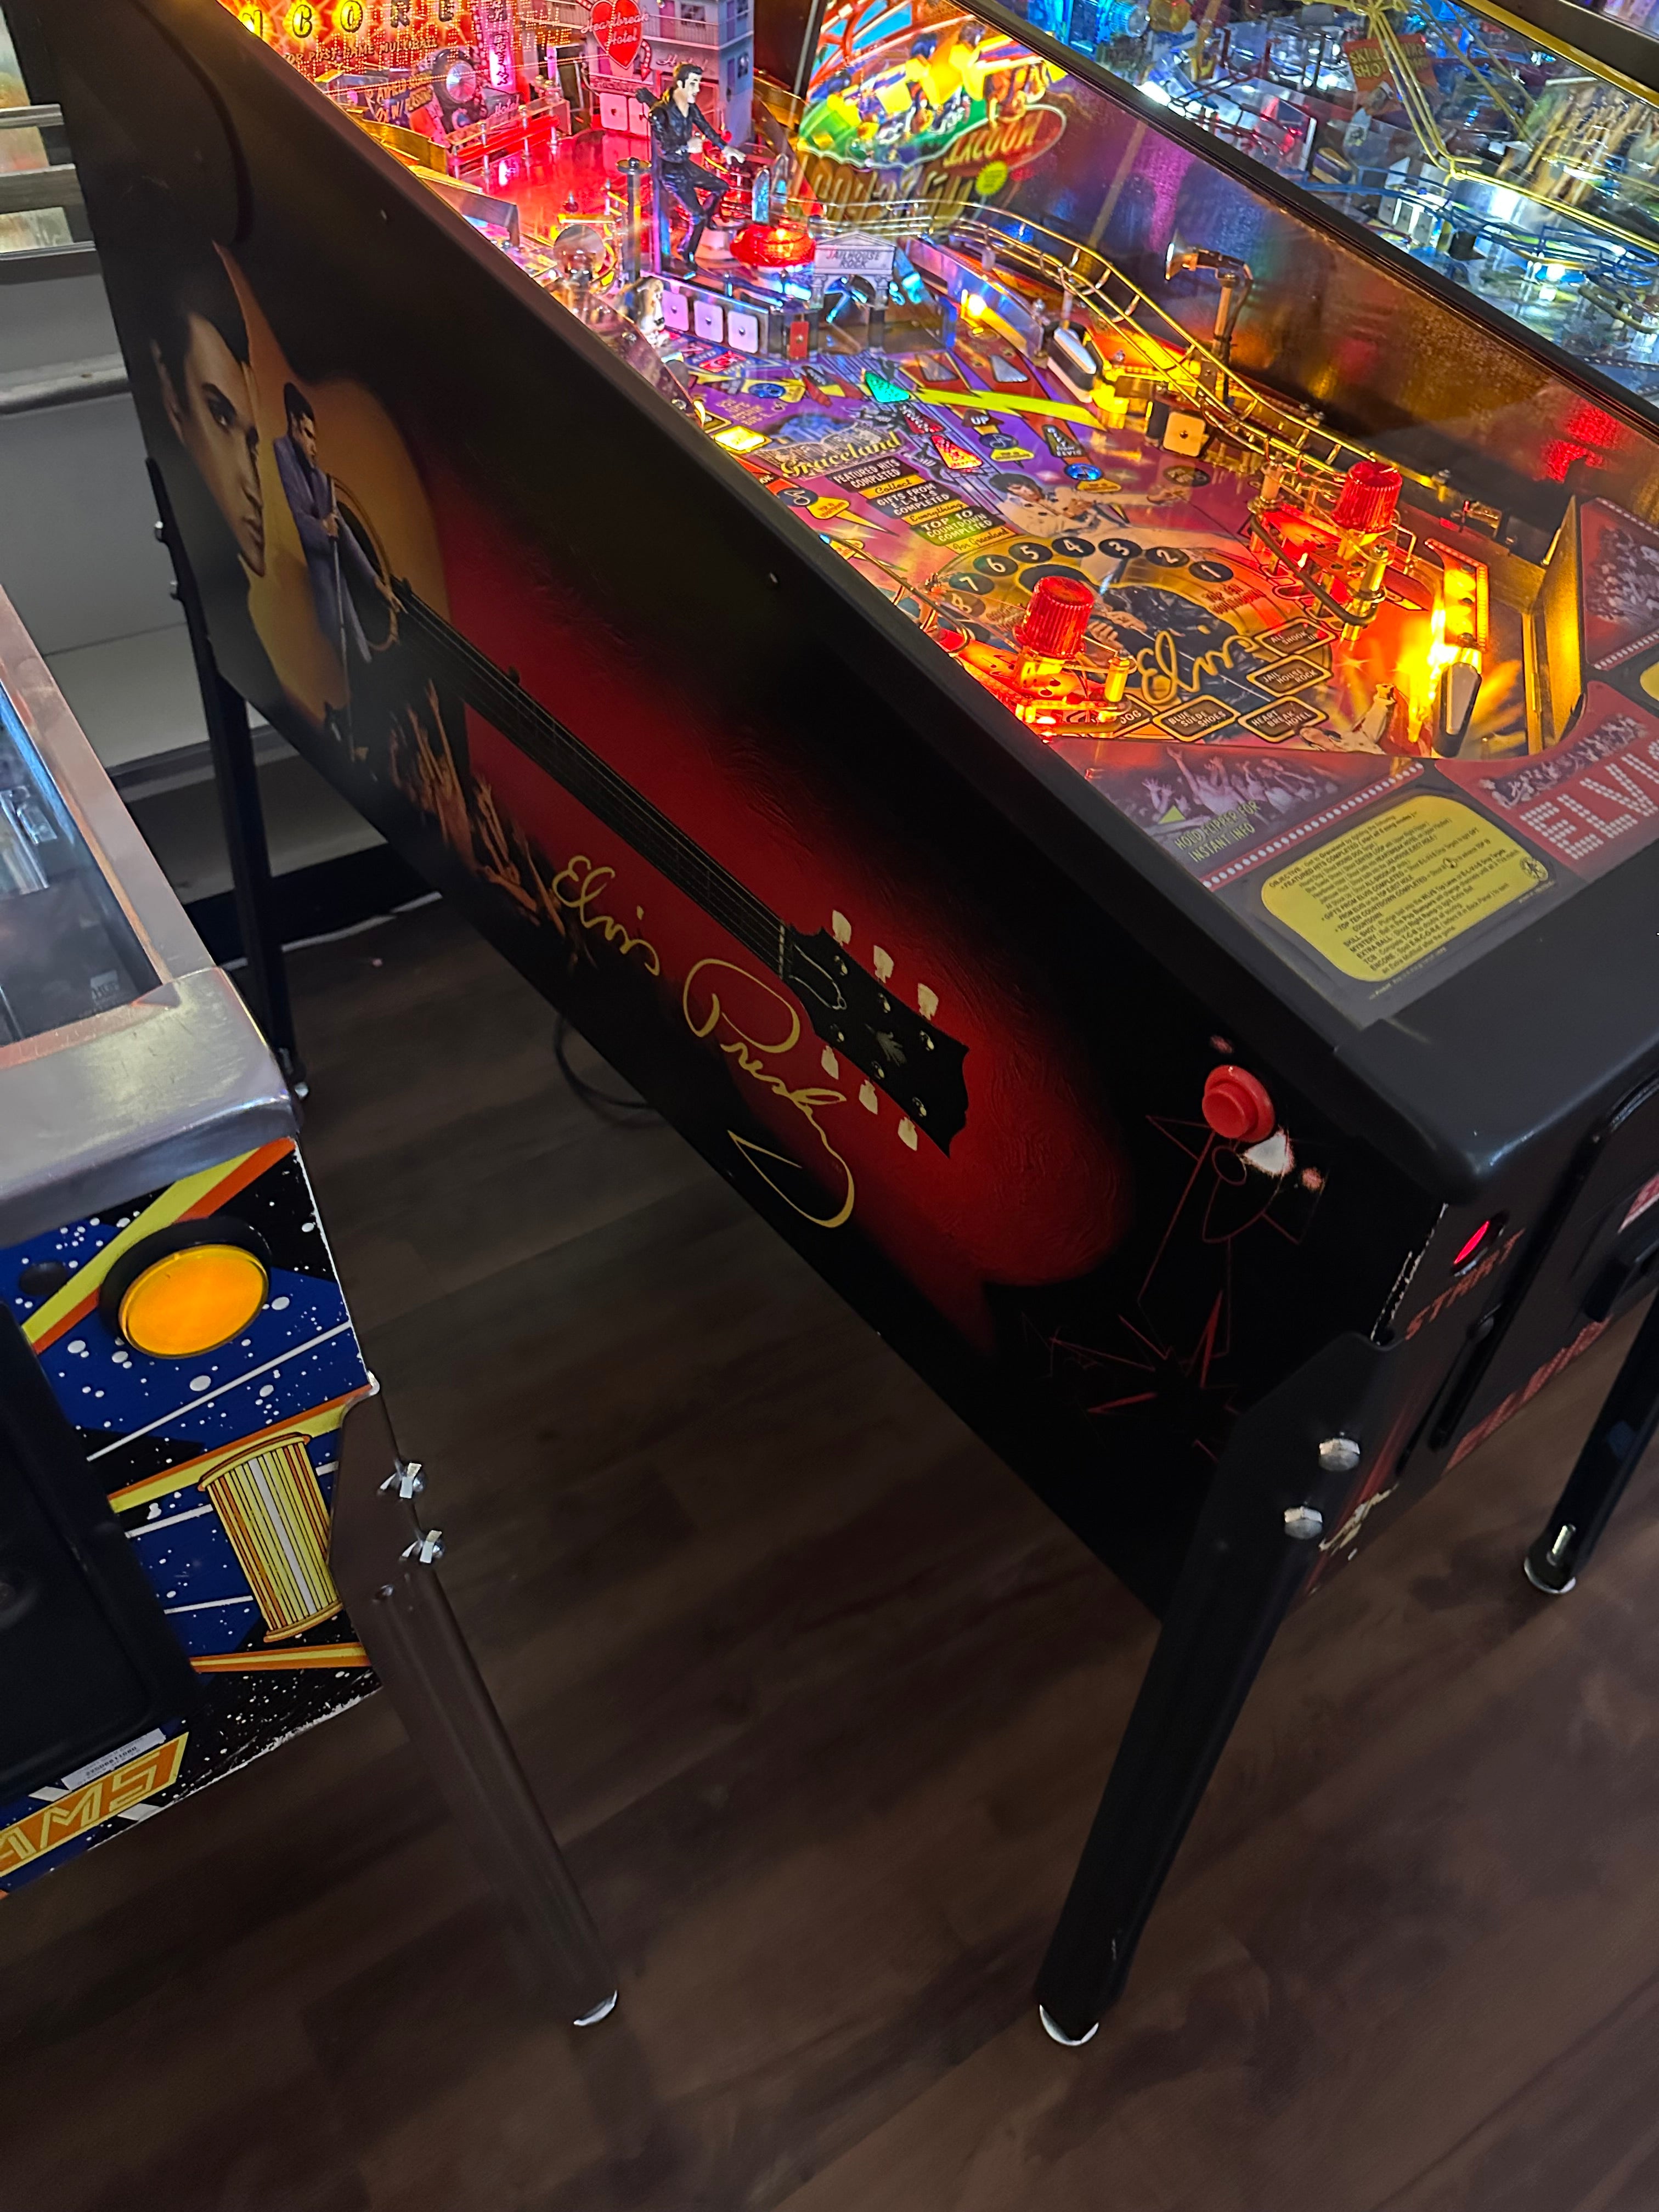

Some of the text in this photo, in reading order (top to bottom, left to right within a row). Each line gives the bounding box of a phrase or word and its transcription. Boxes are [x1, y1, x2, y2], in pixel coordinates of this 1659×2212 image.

[581, 8, 650, 34] Heartbreak
[608, 27, 637, 46] Hotel
[826, 250, 879, 261] JAILHOUSE
[839, 257, 868, 268] ROCK
[970, 415, 989, 425] UP
[781, 431, 902, 477] Graceland
[833, 459, 901, 484] FEATURED HITS
[850, 469, 901, 489] COMPLETED
[875, 479, 913, 494] Collect
[877, 482, 936, 506] GIFTS FROM
[894, 493, 950, 516] COMPLETED
[910, 503, 963, 523] Everything
[921, 510, 973, 532] TOP 10
[926, 514, 987, 538] COUNTDOWN
[939, 520, 992, 542] COMPLETED
[952, 539, 1221, 614] 8 7 6 5 4 3 2 1
[1271, 633, 1284, 644] ALL
[1282, 631, 1308, 645] SHOOK
[1263, 672, 1280, 684] JAIL
[1277, 669, 1305, 684] HOUSE
[1294, 669, 1318, 684] ROCK
[1167, 712, 1190, 726] BLUE
[1180, 711, 1208, 727] SUEDE
[1197, 710, 1227, 727] SHOES
[1251, 710, 1279, 727] HEART
[1266, 710, 1296, 727] BREAK
[1284, 712, 1312, 727] HOTEL
[1520, 738, 1659, 860] ELVI
[1175, 799, 1261, 851] HOLD FLIPPER FOR
[1188, 822, 1256, 862] INSTANT INFO
[1282, 867, 1314, 888] FEATURED
[1311, 860, 1328, 871] HITS
[1323, 840, 1359, 864] COMPLETED
[1339, 897, 1359, 911] FROM
[1355, 889, 1374, 901] ELVIS
[1370, 870, 1405, 893] COMPLETED
[1336, 920, 1352, 930] TOP
[1348, 914, 1363, 924] TEN
[1359, 893, 1397, 917] COUNTDOWN
[1356, 944, 1379, 959] EXTRA
[1374, 935, 1393, 947] BALL
